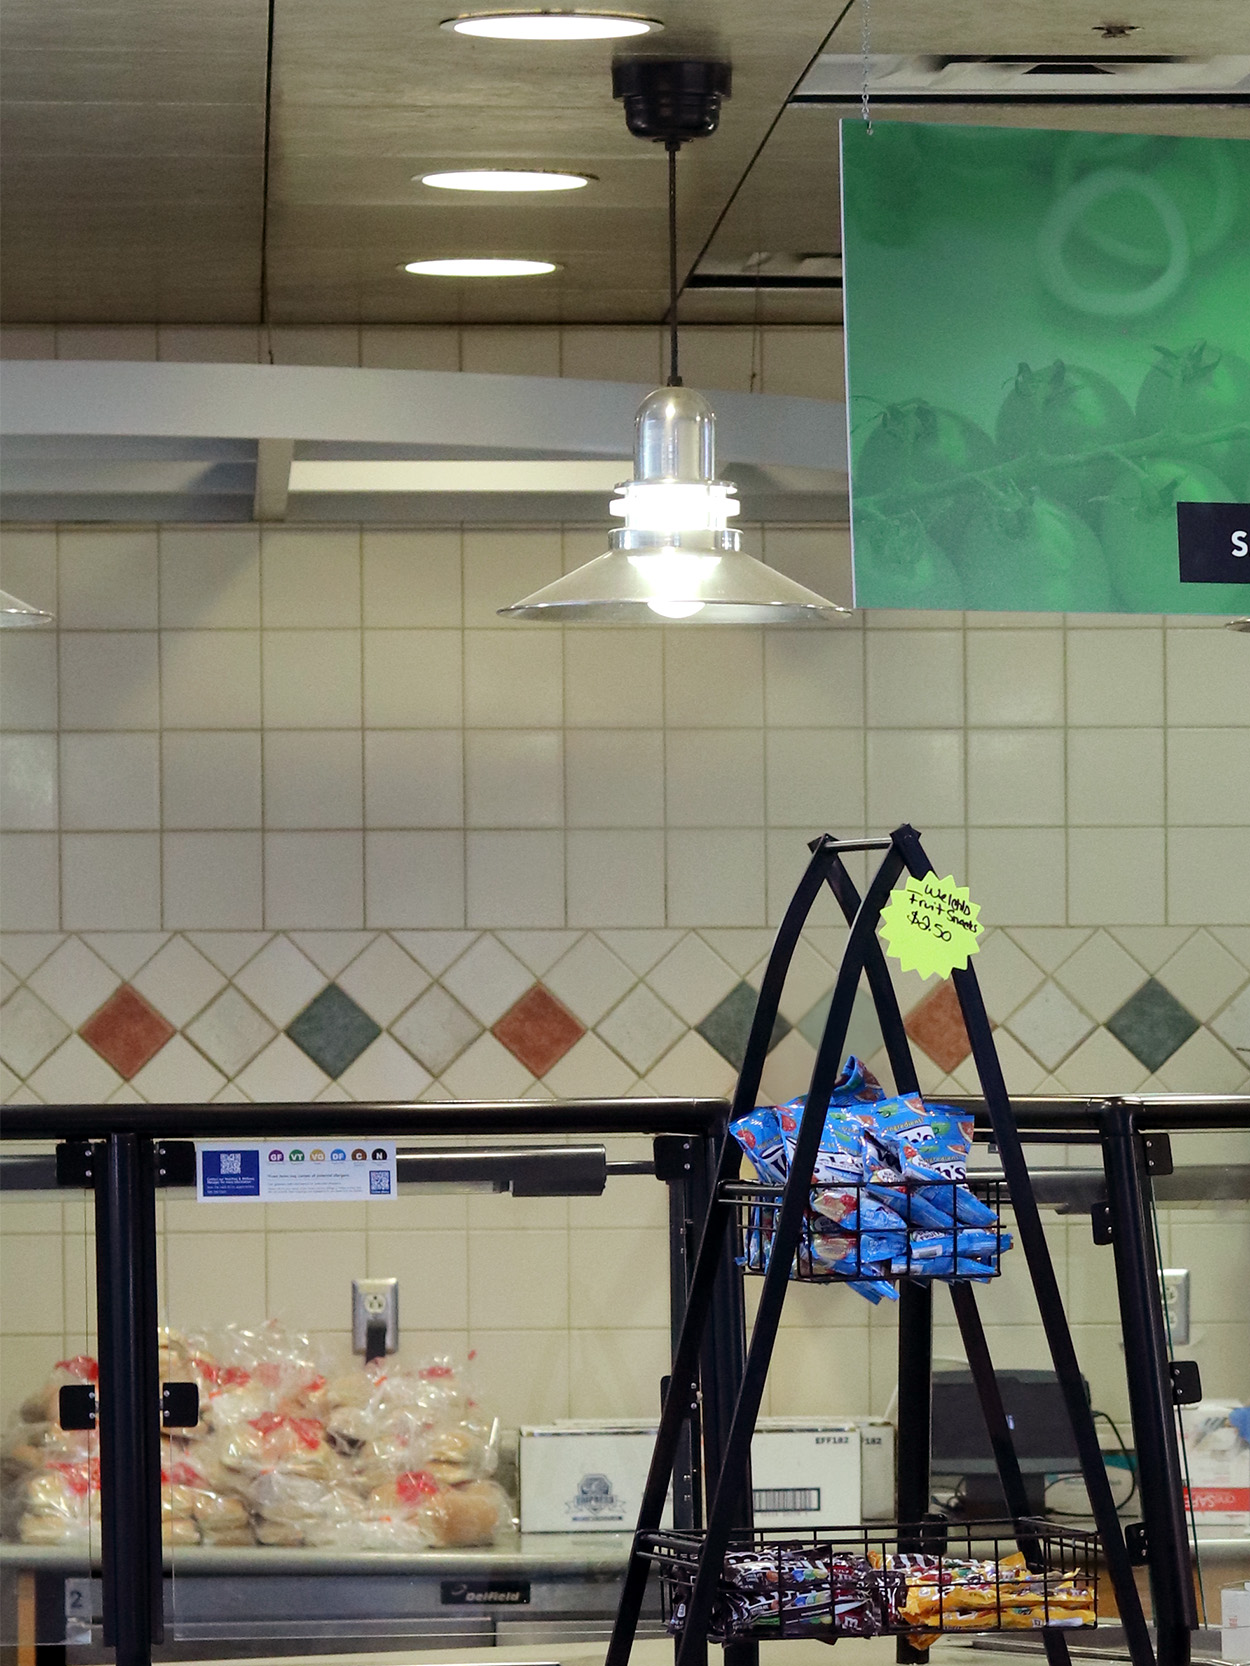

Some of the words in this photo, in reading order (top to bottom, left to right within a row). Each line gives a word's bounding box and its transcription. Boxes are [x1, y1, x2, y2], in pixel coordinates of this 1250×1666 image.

[907, 911, 952, 942] $2.50
[815, 1437, 849, 1445] EFF182
[71, 1590, 82, 1608] 2
[466, 1591, 520, 1602] Delfield
